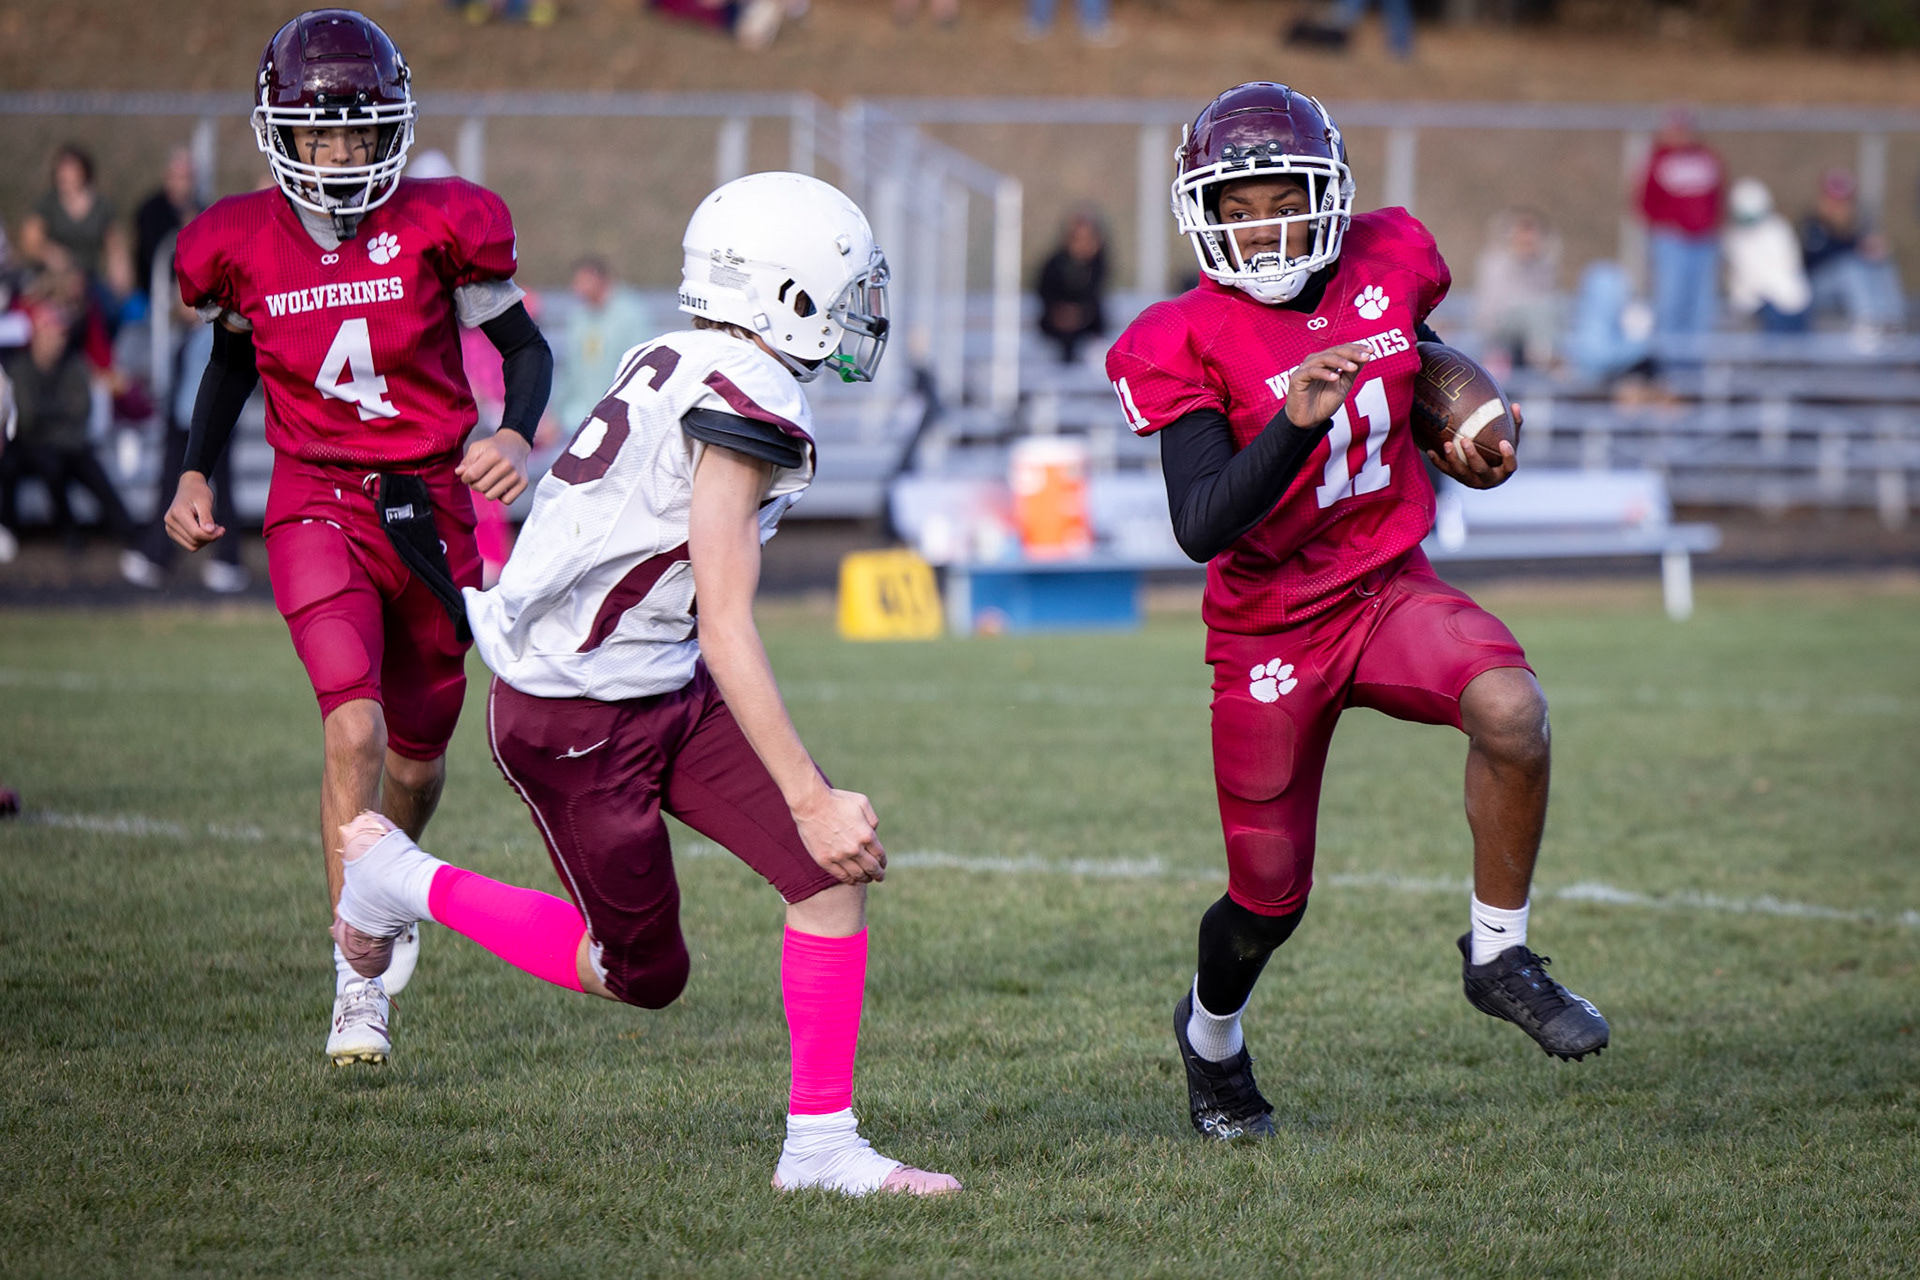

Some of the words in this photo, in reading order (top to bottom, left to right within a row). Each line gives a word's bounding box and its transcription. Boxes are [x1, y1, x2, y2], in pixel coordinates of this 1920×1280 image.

[265, 276, 404, 317] WOLVERINES
[314, 317, 401, 421] 4
[552, 342, 682, 486] 6
[1112, 376, 1151, 432] 11
[1316, 376, 1391, 509] 11
